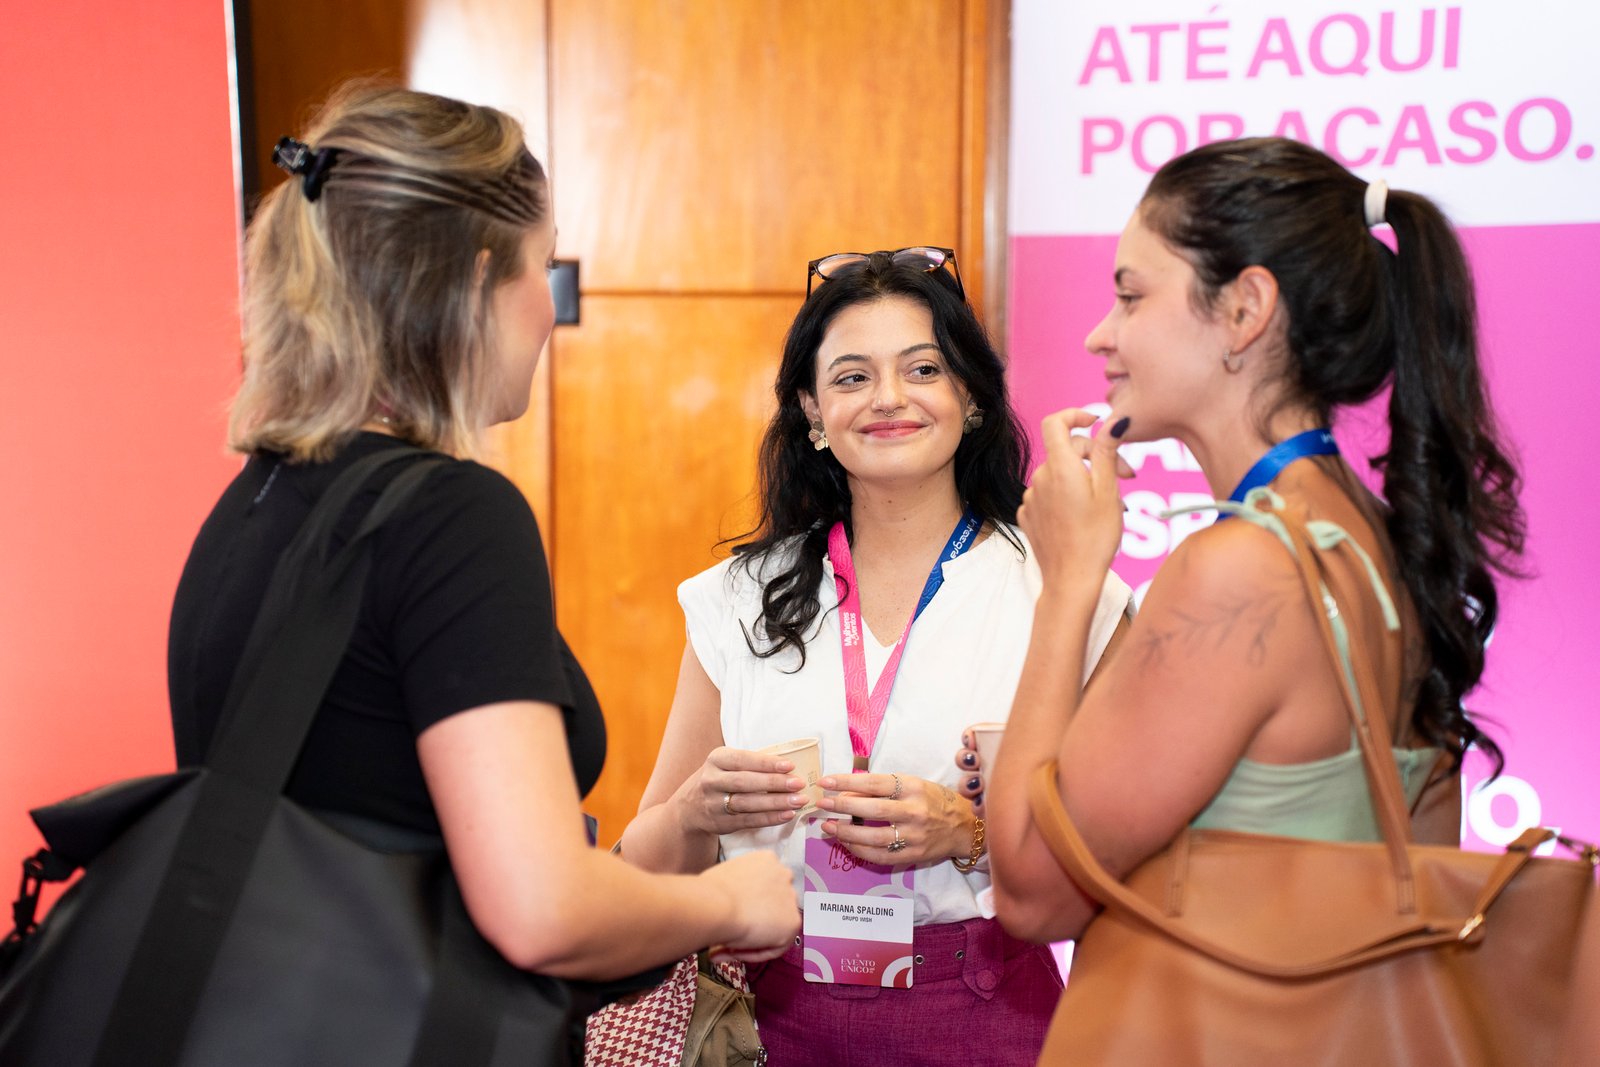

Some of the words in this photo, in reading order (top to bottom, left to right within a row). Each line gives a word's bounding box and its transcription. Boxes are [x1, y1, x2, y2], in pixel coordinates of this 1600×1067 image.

[1078, 5, 1230, 86] ATÉ
[1246, 7, 1463, 78] AQUI
[820, 902, 855, 914] MARIANA
[857, 905, 894, 917] SPALDING
[841, 958, 876, 967] EVENTO
